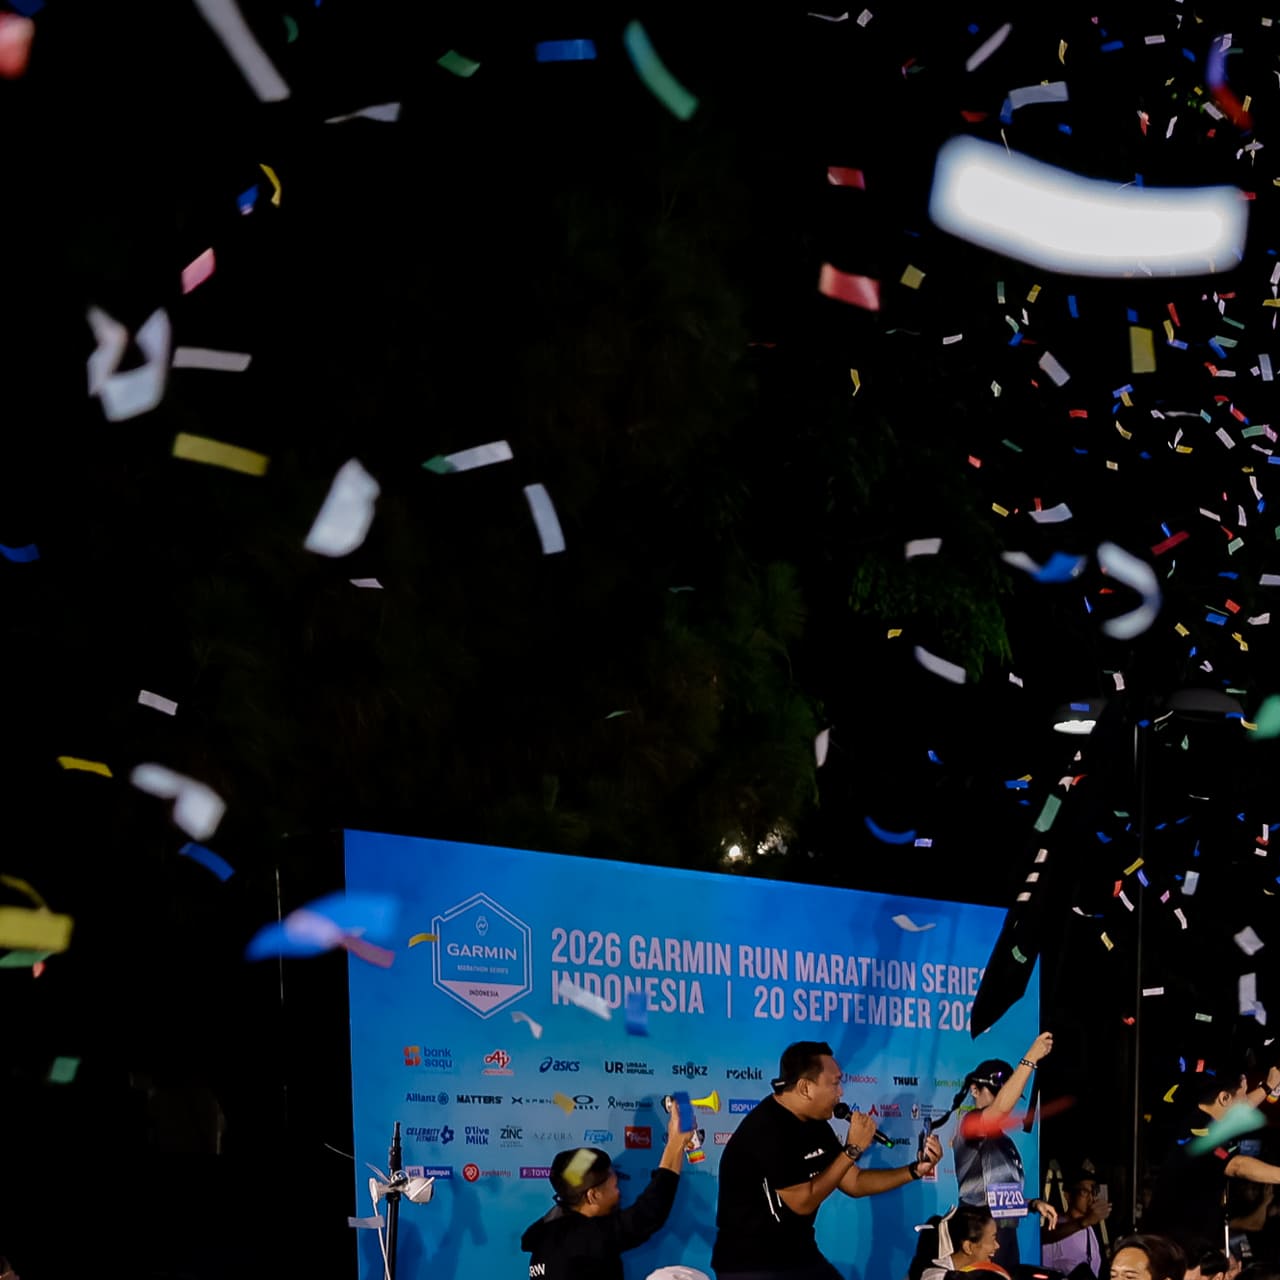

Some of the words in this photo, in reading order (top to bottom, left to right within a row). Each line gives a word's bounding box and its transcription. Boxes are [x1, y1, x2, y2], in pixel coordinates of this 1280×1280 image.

[446, 943, 518, 961] GARMIN
[551, 927, 622, 967] 2026
[628, 934, 732, 977] GARMIN
[738, 944, 789, 982] RUN
[794, 950, 917, 991] MARATHON
[469, 988, 499, 998] INDONESIA
[753, 984, 784, 1020] 20
[793, 989, 932, 1029] SEPTEMBER
[938, 1001, 991, 1033] 202
[424, 1045, 451, 1057] bank
[424, 1058, 452, 1070] saqu
[605, 1061, 624, 1074] UR
[672, 1064, 708, 1077] SHOKZ
[726, 1067, 763, 1080] rockit
[893, 1076, 919, 1086] THULE
[406, 1092, 436, 1103] Allianz
[456, 1095, 502, 1104] MATTERS
[406, 1127, 440, 1136] CELEBRITY
[465, 1135, 489, 1145] Milk
[996, 1190, 1025, 1206] 7220
